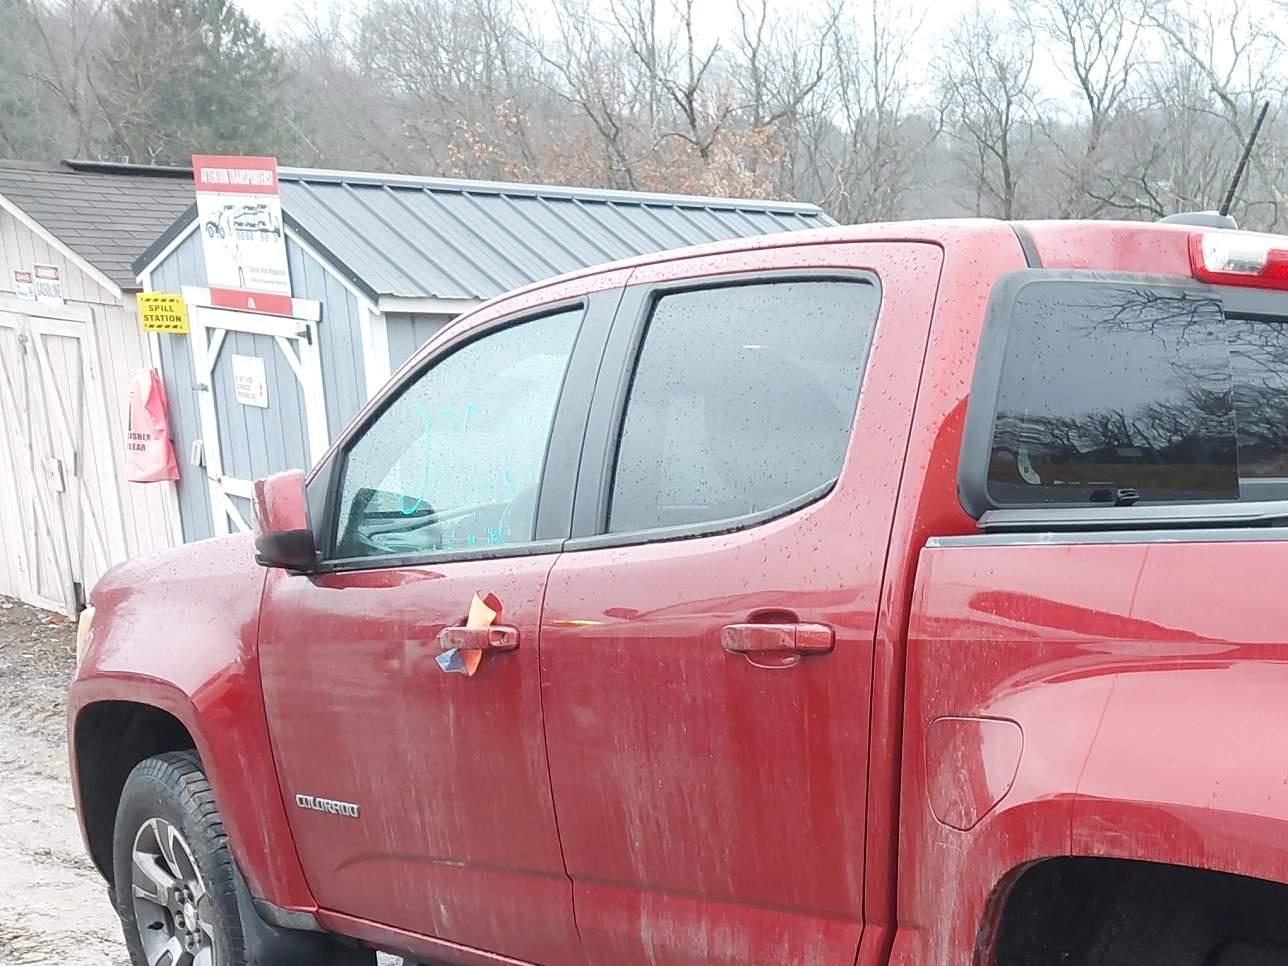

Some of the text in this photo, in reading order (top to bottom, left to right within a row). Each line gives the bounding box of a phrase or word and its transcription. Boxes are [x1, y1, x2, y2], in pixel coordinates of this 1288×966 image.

[148, 304, 175, 313] SPILL
[143, 314, 182, 322] STATION
[295, 793, 360, 818] COLORADO
